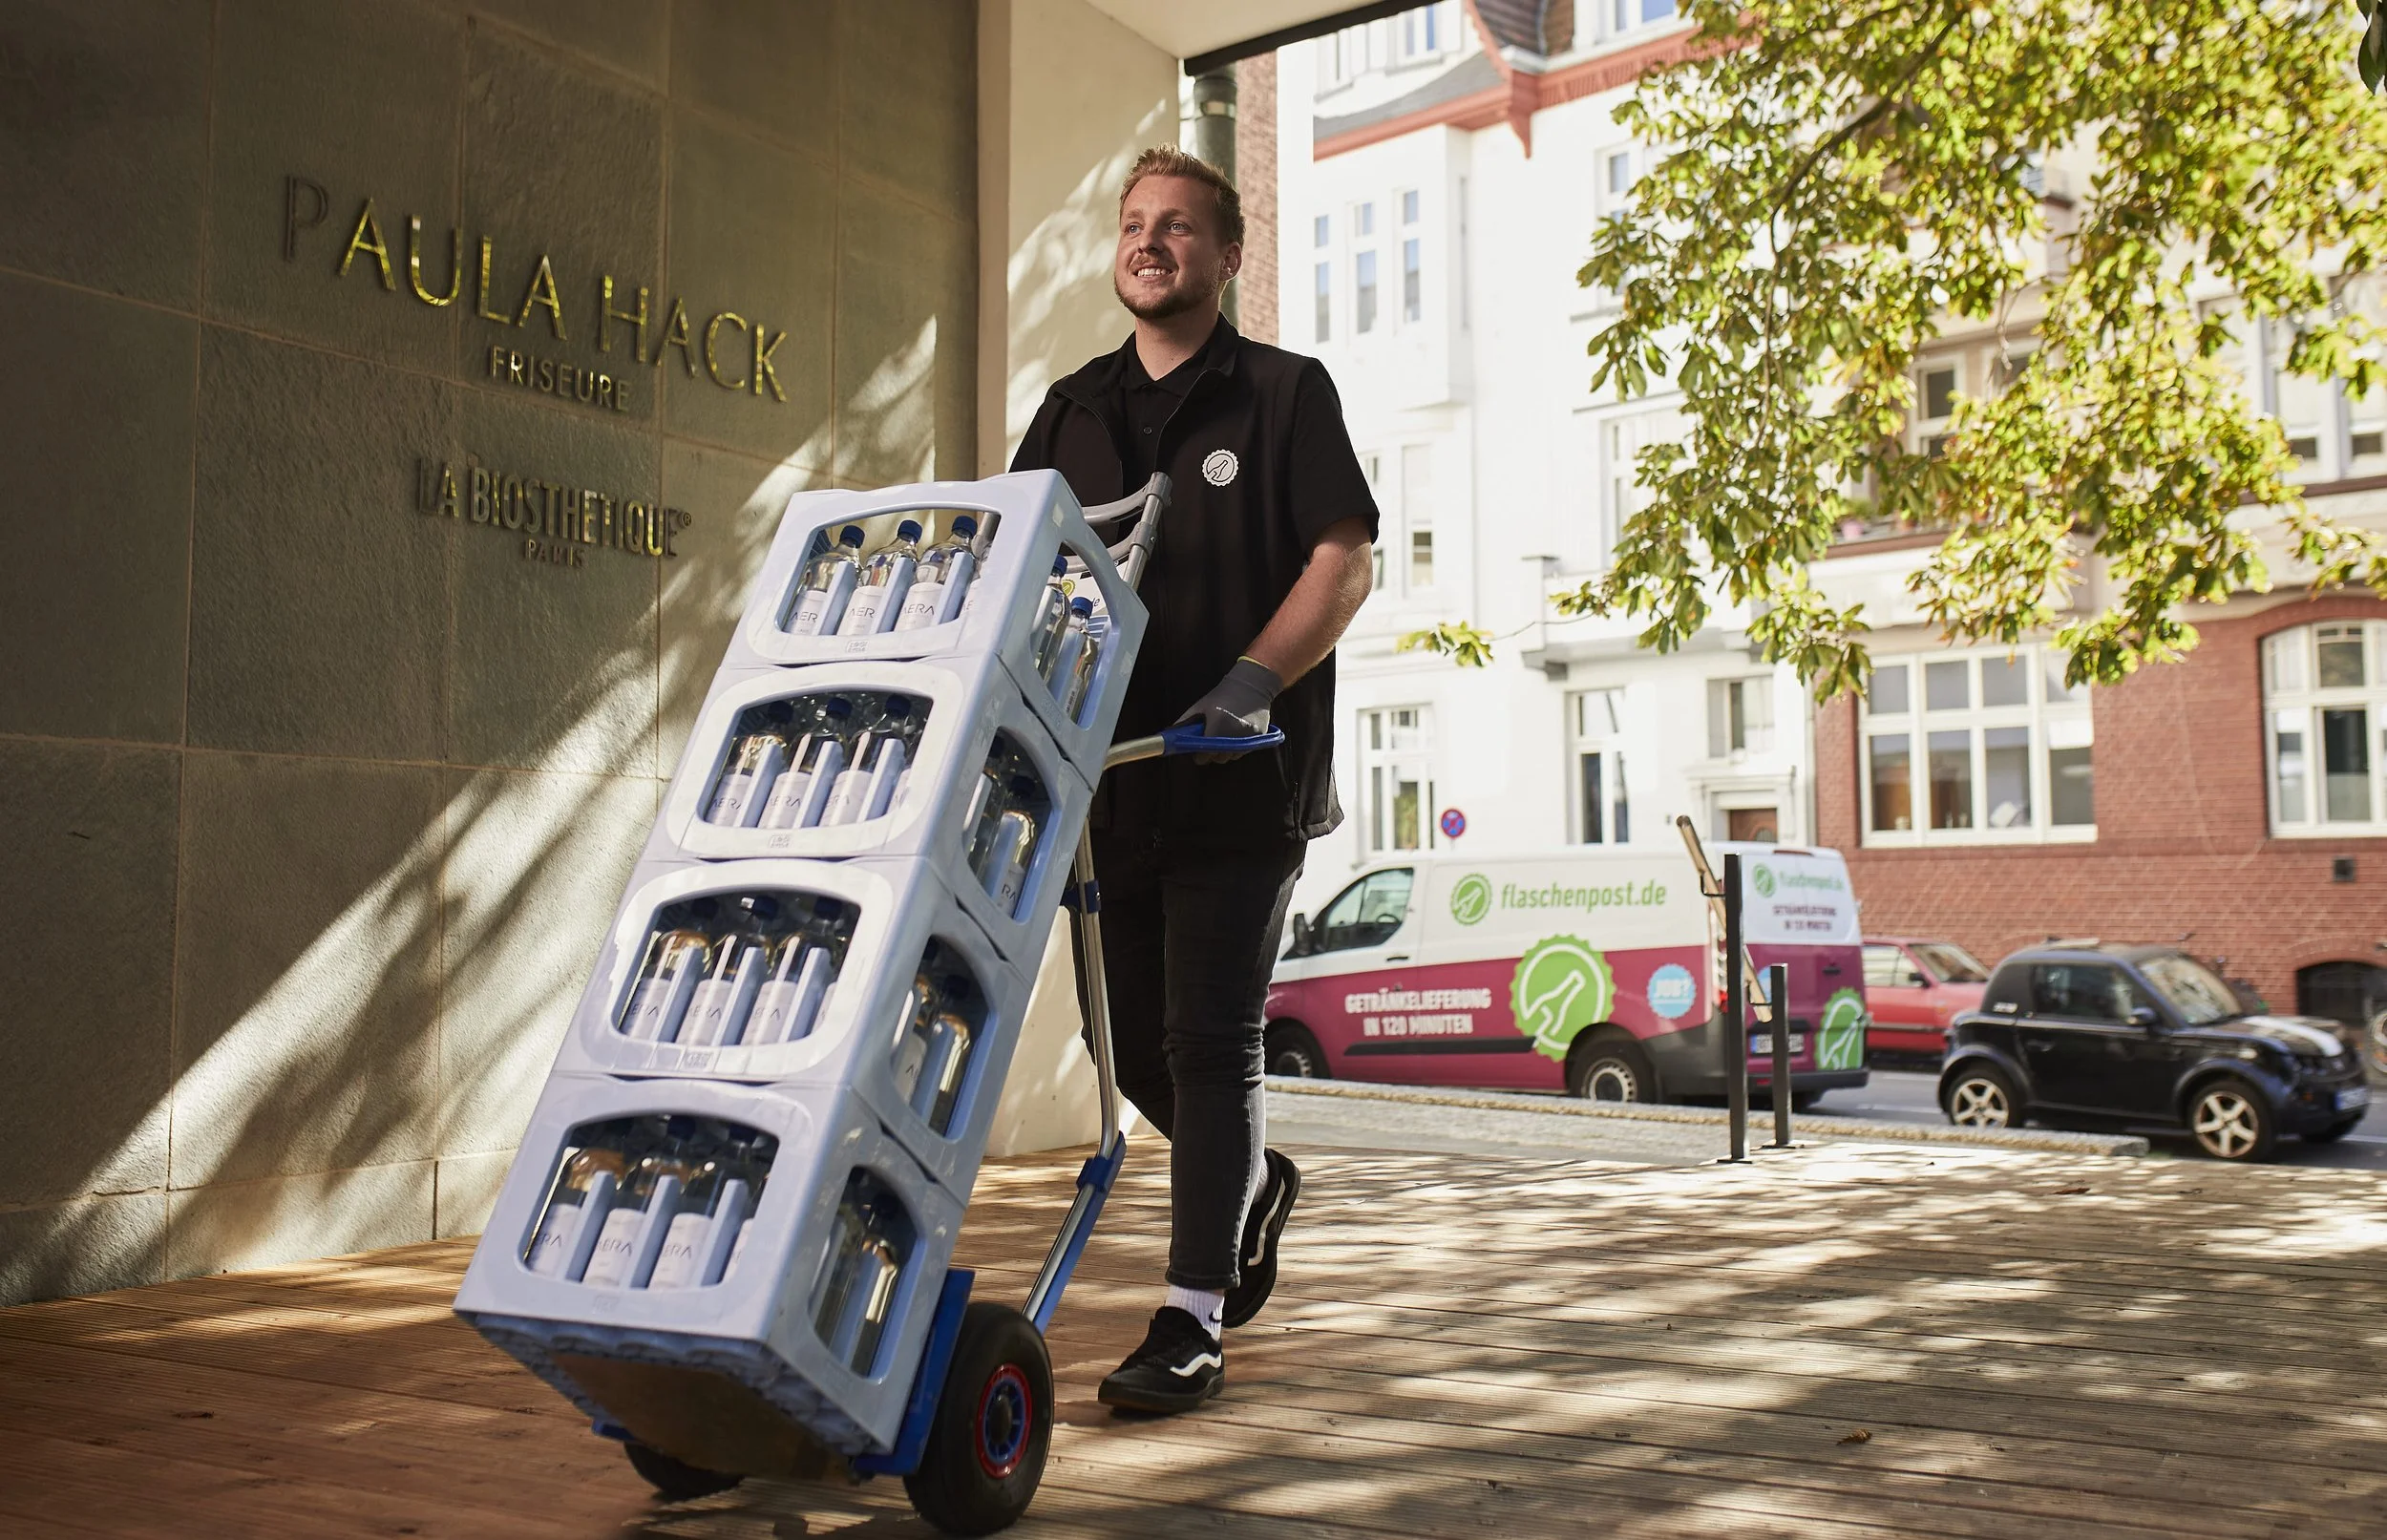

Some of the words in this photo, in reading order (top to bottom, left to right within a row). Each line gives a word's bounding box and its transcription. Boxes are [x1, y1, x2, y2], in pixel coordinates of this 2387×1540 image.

[285, 175, 567, 342] PAULA
[600, 275, 788, 403] HACK
[489, 345, 630, 412] FRISEURE
[418, 457, 460, 518] LA
[526, 538, 588, 568] PARIS
[790, 611, 818, 623] AER
[848, 606, 876, 619] AER
[1500, 878, 1667, 914] flaschenpost.de
